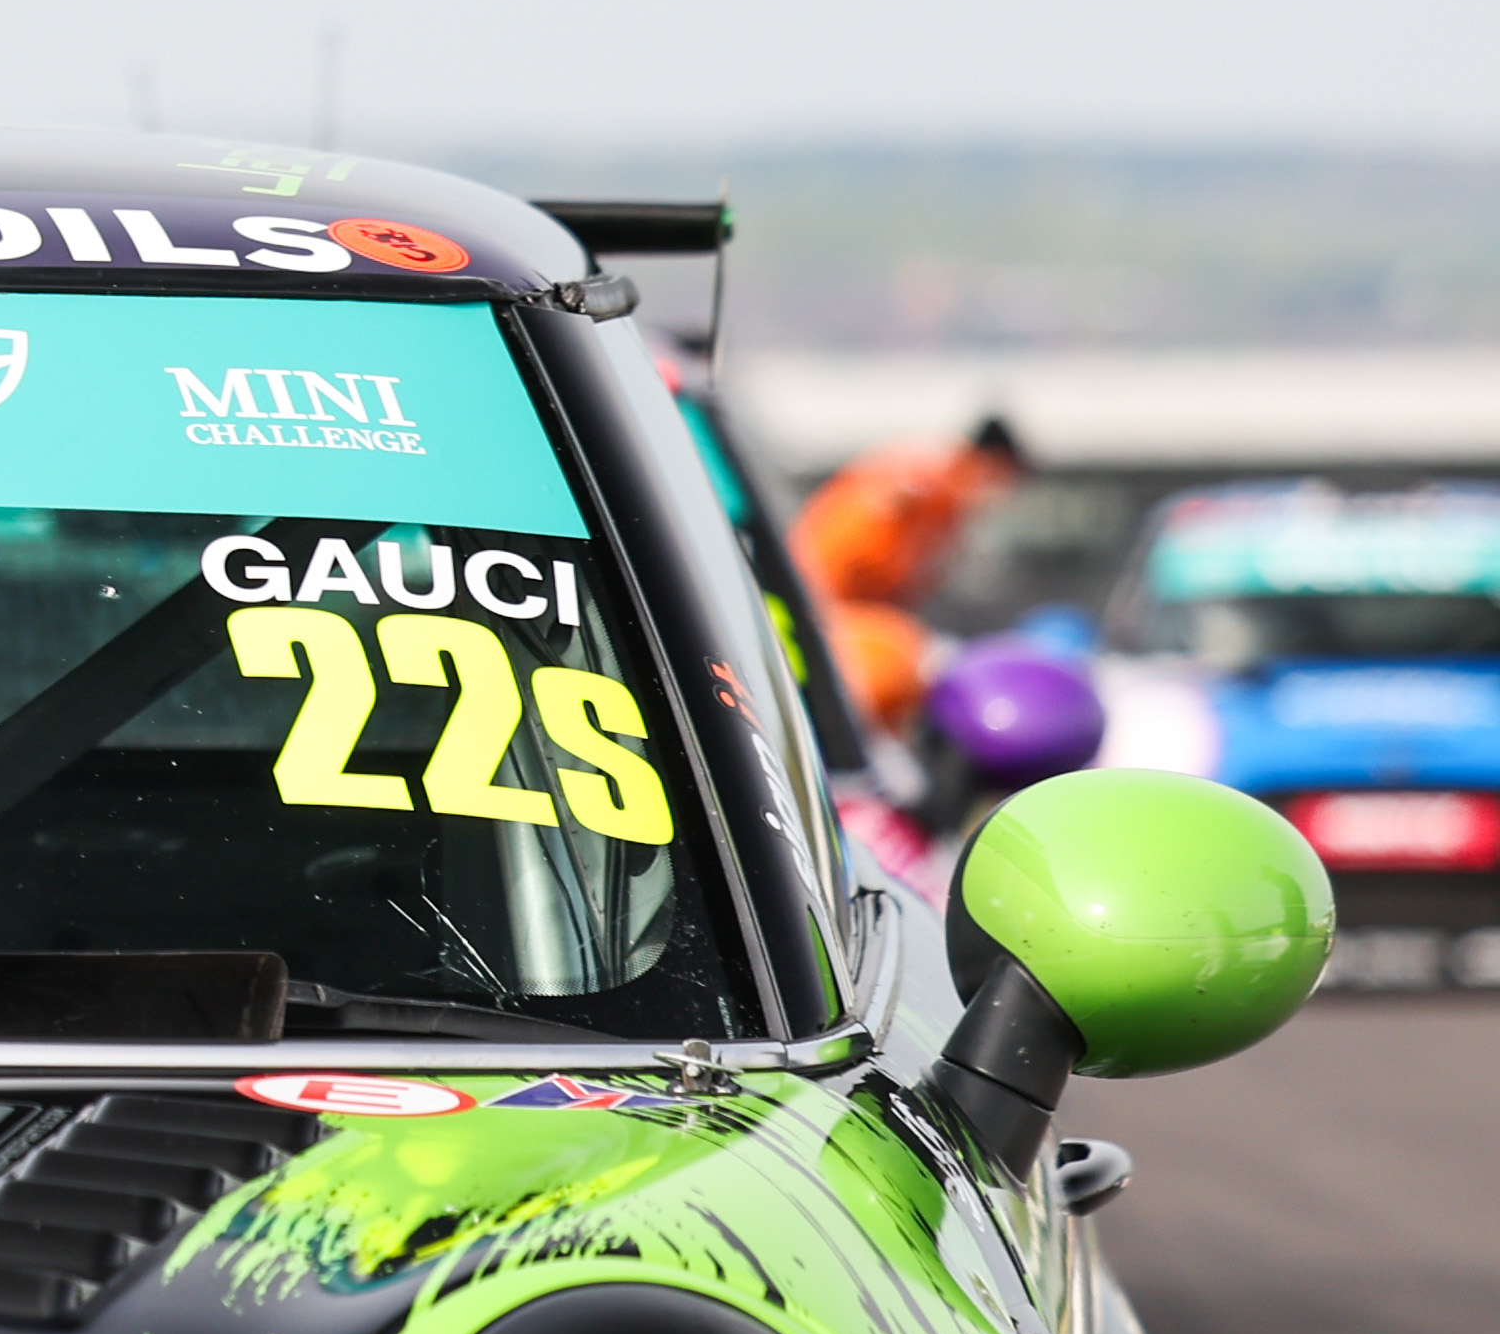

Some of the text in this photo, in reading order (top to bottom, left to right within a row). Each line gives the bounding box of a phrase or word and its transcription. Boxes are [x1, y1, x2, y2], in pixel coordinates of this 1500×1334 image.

[163, 367, 418, 427] MINI
[185, 423, 427, 455] CHALLENGE
[200, 535, 582, 627] GAUCI
